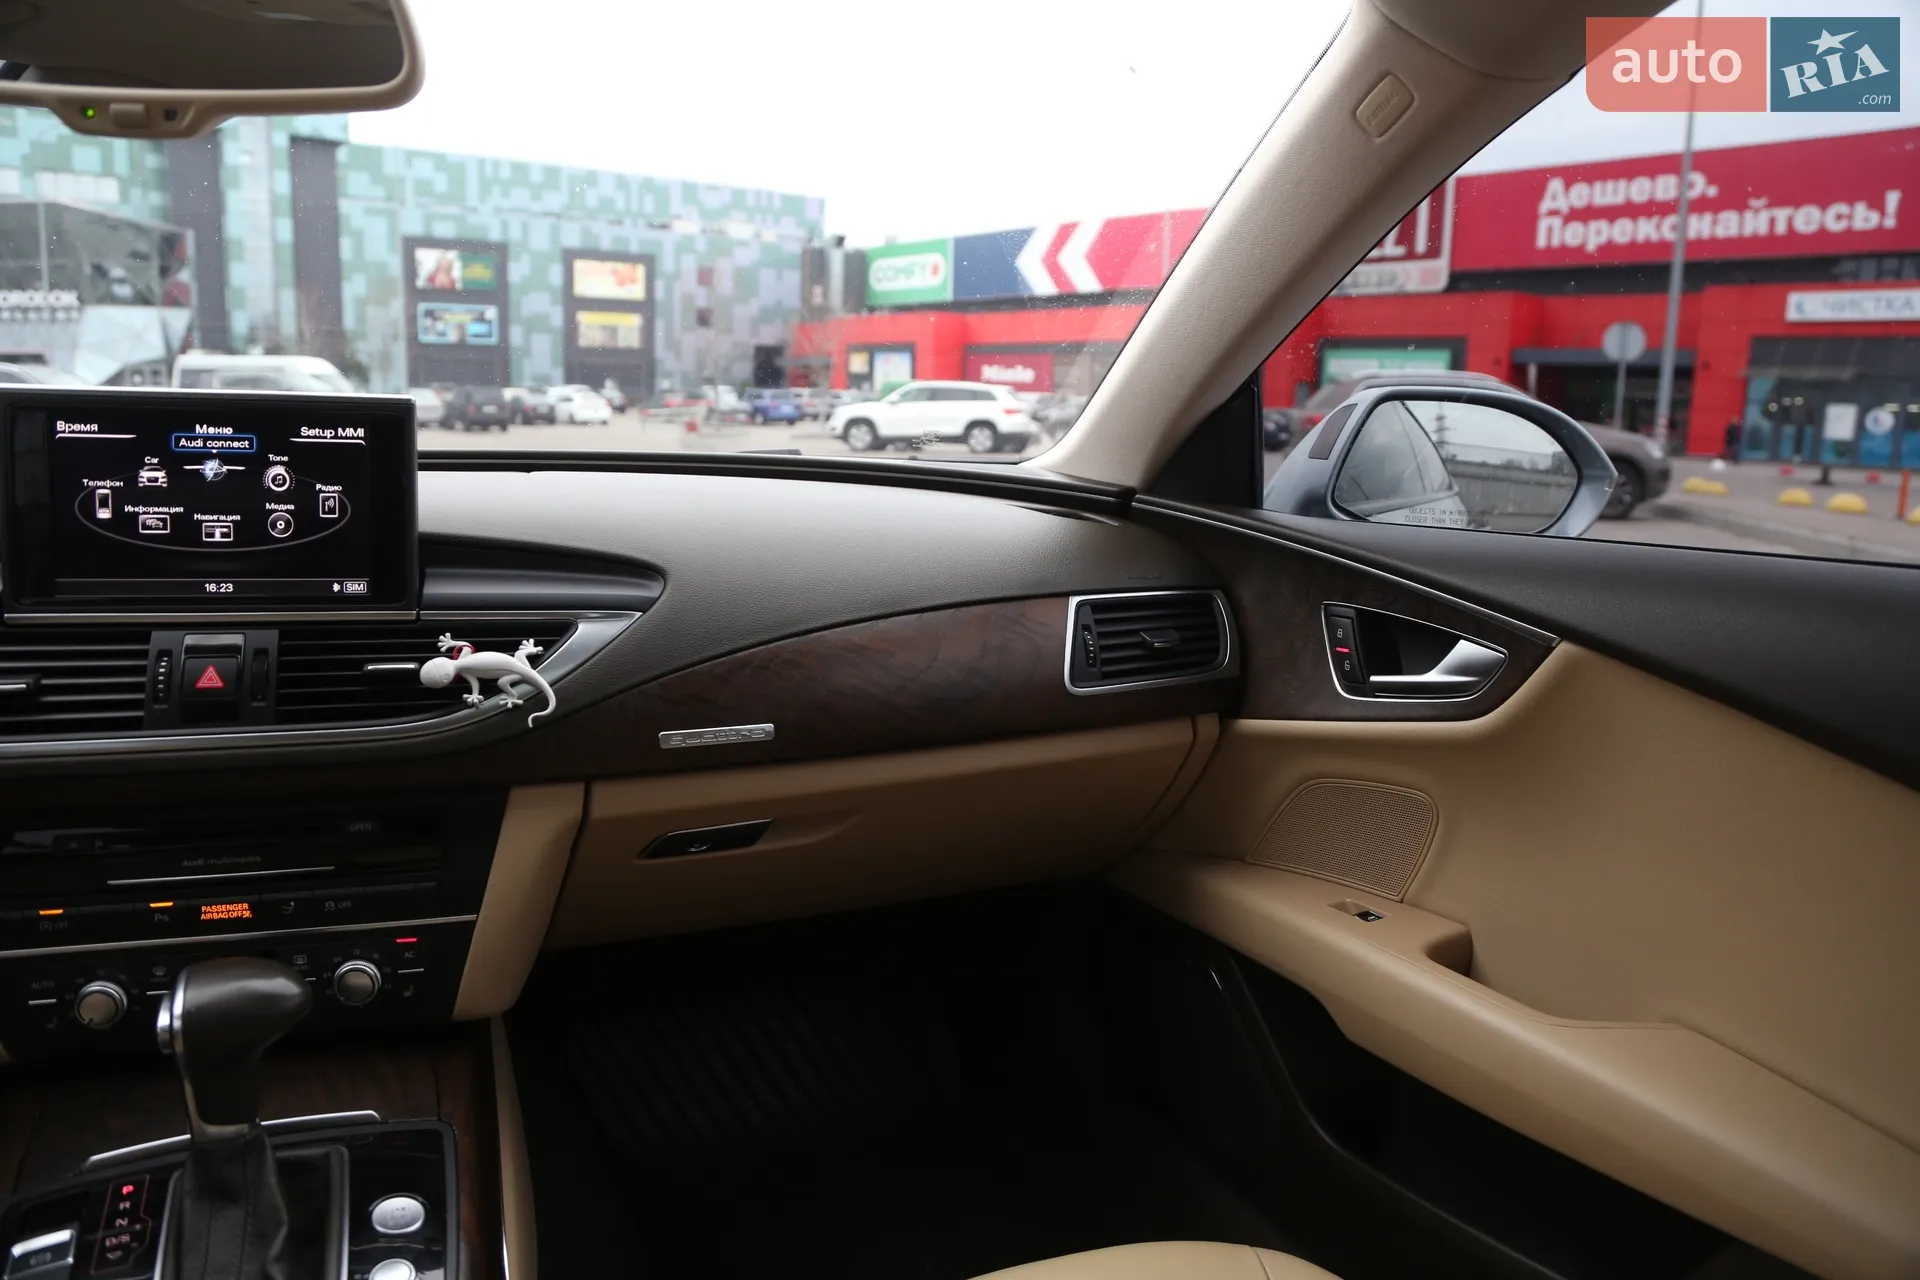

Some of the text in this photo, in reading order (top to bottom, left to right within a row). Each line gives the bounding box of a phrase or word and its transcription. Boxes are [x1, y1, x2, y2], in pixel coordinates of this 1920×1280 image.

[1538, 170, 1719, 216] Дешево.
[1535, 188, 1903, 254] Переконайтесь!
[56, 420, 99, 433] Время
[195, 424, 233, 434] Меню
[300, 427, 365, 439] Setup MMI
[178, 438, 250, 448] Audi connect
[144, 456, 160, 464] Car
[268, 454, 289, 462] Tone
[82, 478, 124, 488] Телефон
[315, 483, 343, 492] Радио
[124, 504, 184, 514] Информация
[265, 502, 295, 511] Медиа
[1408, 507, 1436, 516] OBJECTS
[194, 513, 241, 522] Навигация
[1404, 515, 1428, 524] CLOSER
[1431, 517, 1446, 525] THAN
[1449, 518, 1465, 526] THEY
[204, 583, 234, 592] 16:23
[346, 582, 364, 591] SIM
[201, 903, 249, 913] PASSENGER
[200, 910, 243, 920] AIRBAG OFF
[403, 951, 415, 959] AC
[31, 980, 55, 990] AUTO
[121, 1184, 136, 1196] P
